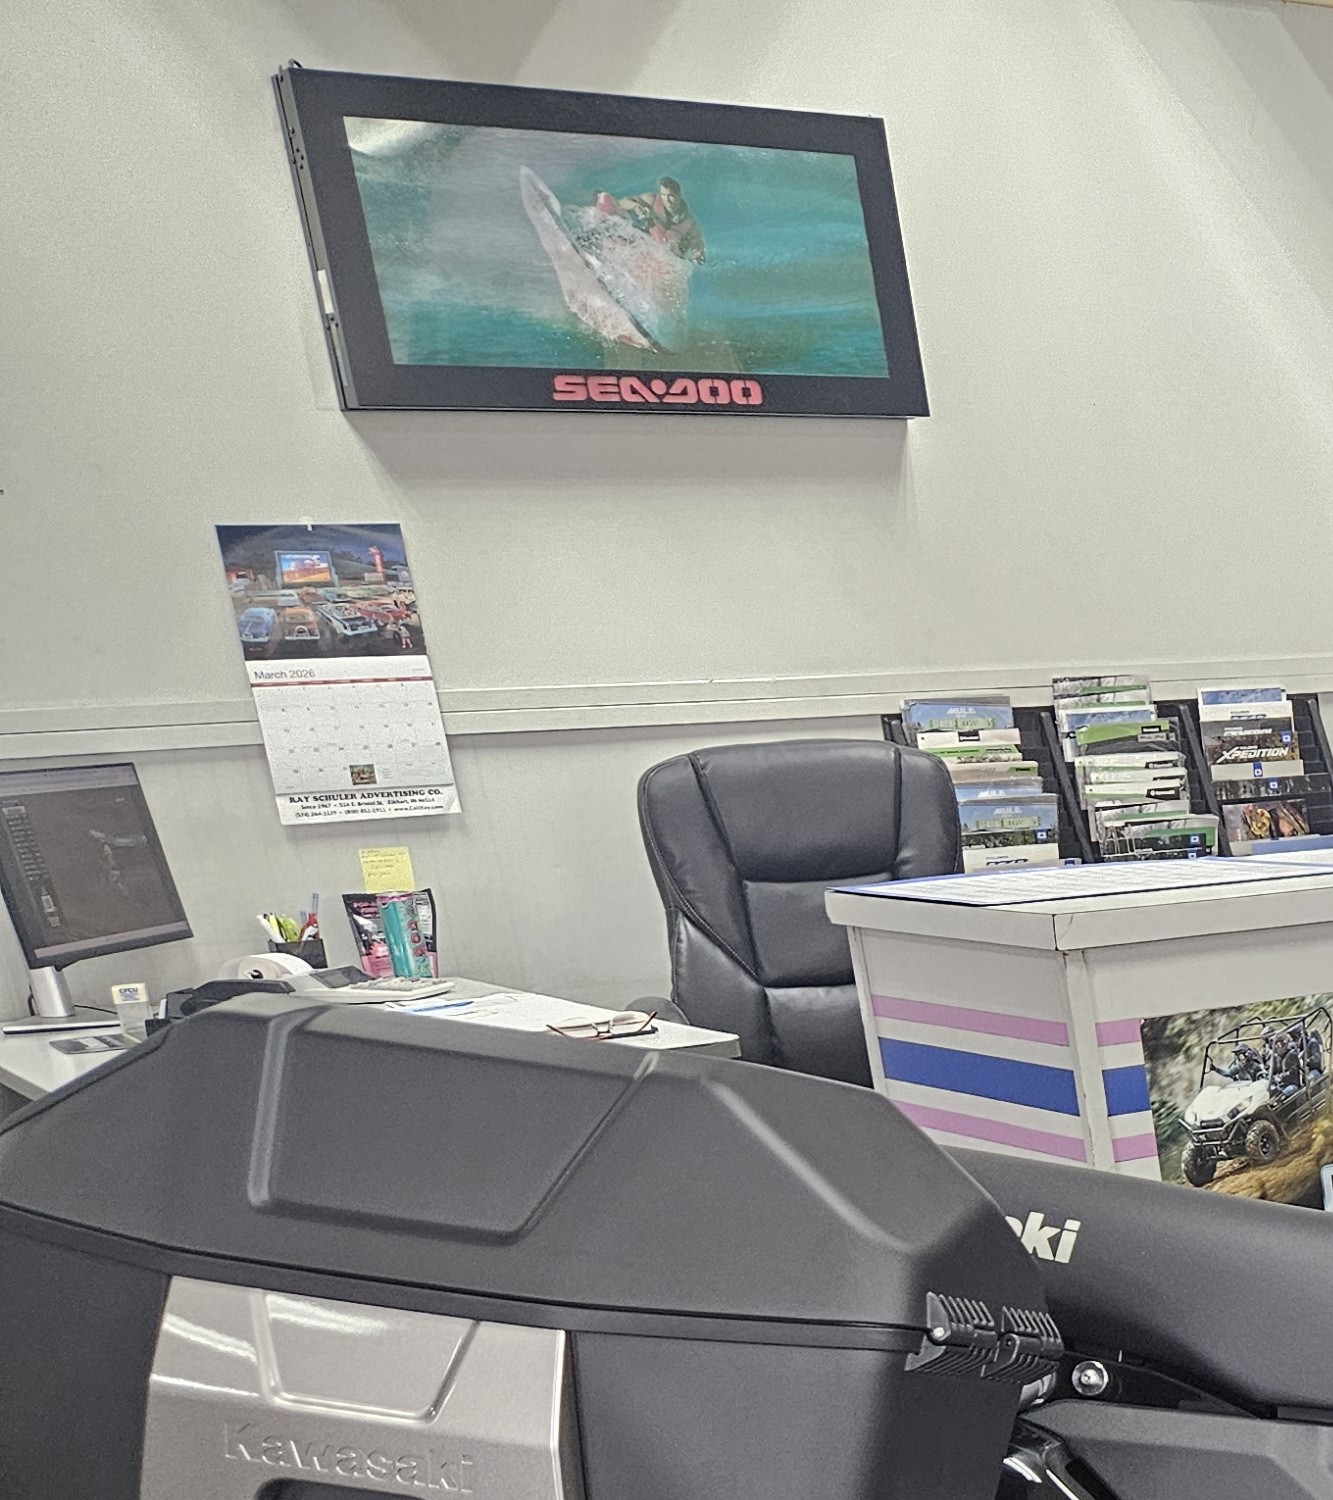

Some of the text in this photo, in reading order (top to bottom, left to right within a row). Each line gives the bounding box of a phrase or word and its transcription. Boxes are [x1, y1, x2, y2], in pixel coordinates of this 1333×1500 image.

[254, 669, 316, 680] March 2026
[1216, 746, 1289, 764] XPEDITION
[289, 788, 443, 804] RAY SCHULER ADVERTISING CO.
[223, 1422, 474, 1494] Kawasaki
